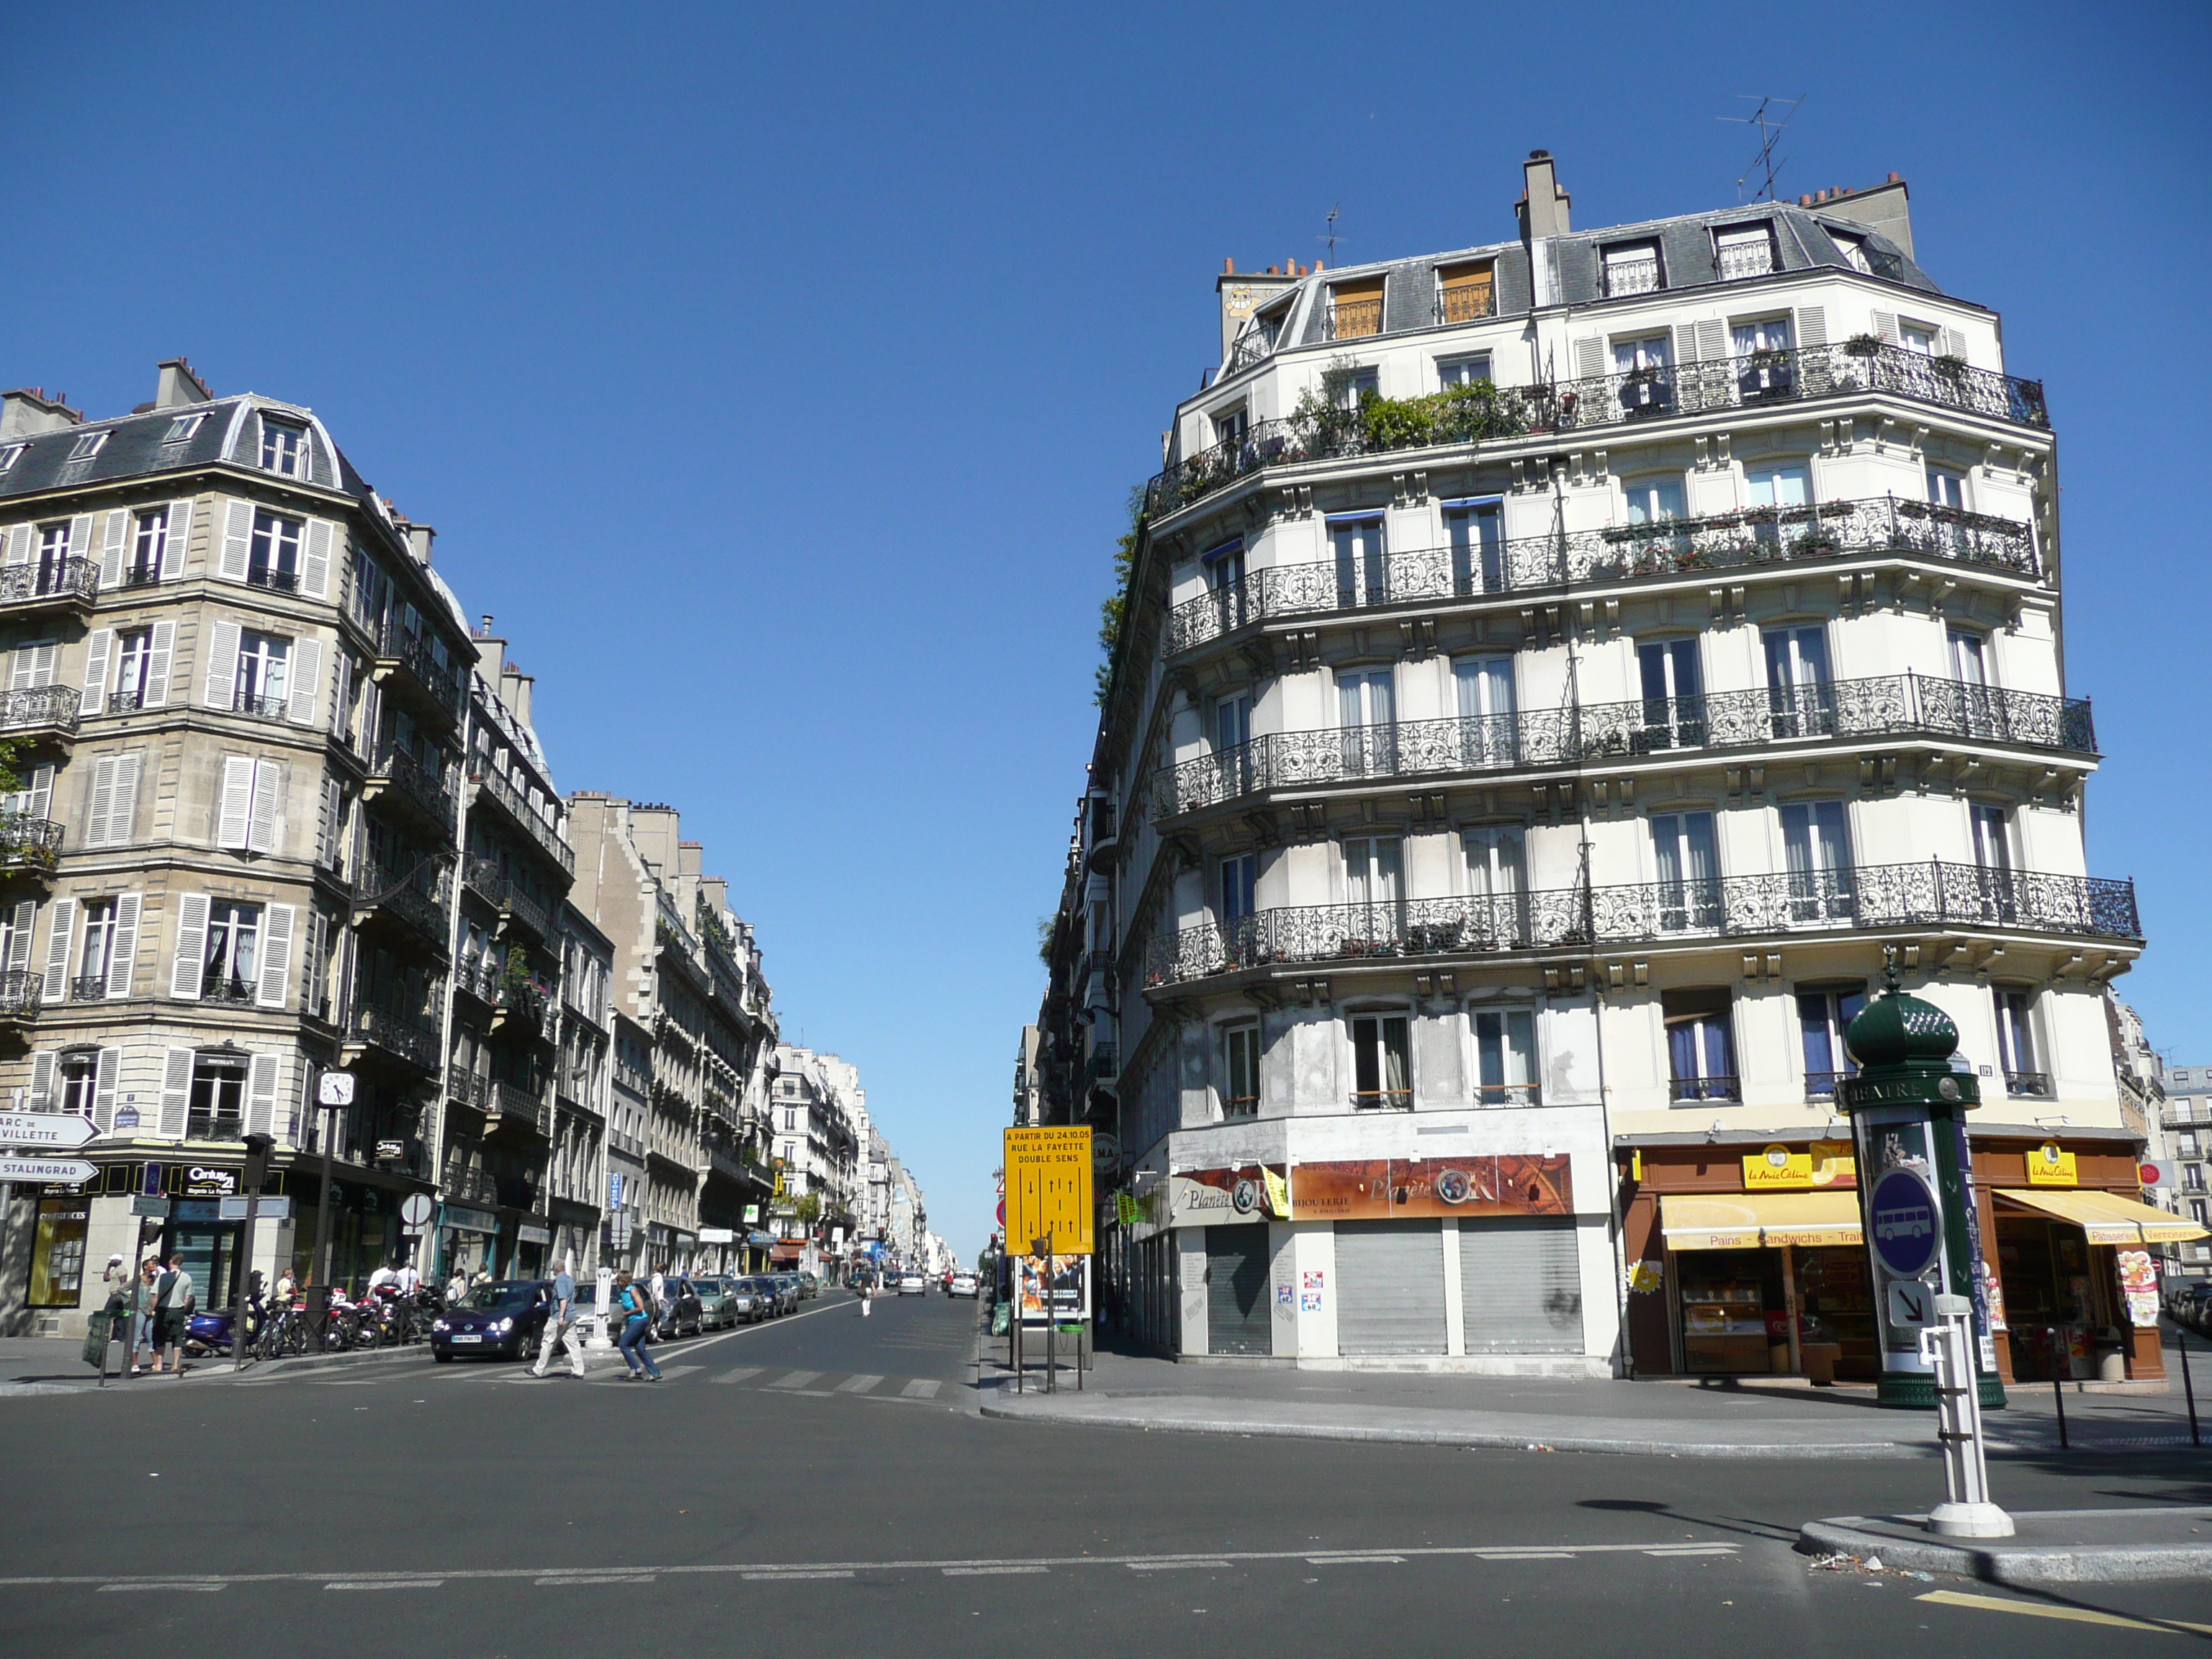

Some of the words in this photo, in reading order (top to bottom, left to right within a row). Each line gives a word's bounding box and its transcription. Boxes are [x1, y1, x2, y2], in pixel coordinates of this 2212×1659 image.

[3, 1129, 58, 1141] VILLETTE
[4, 1164, 77, 1175] STALINGRAD
[189, 1167, 228, 1181] Century
[222, 1176, 235, 1188] 21
[1370, 1179, 1431, 1201] Planète
[1190, 1190, 1230, 1209] Planète
[1292, 1197, 1350, 1208] BIJOUTERIE
[1710, 1235, 1741, 1246] Pains
[1758, 1232, 1822, 1245] Sandwichs
[2091, 1230, 2138, 1241] Pâtisseries
